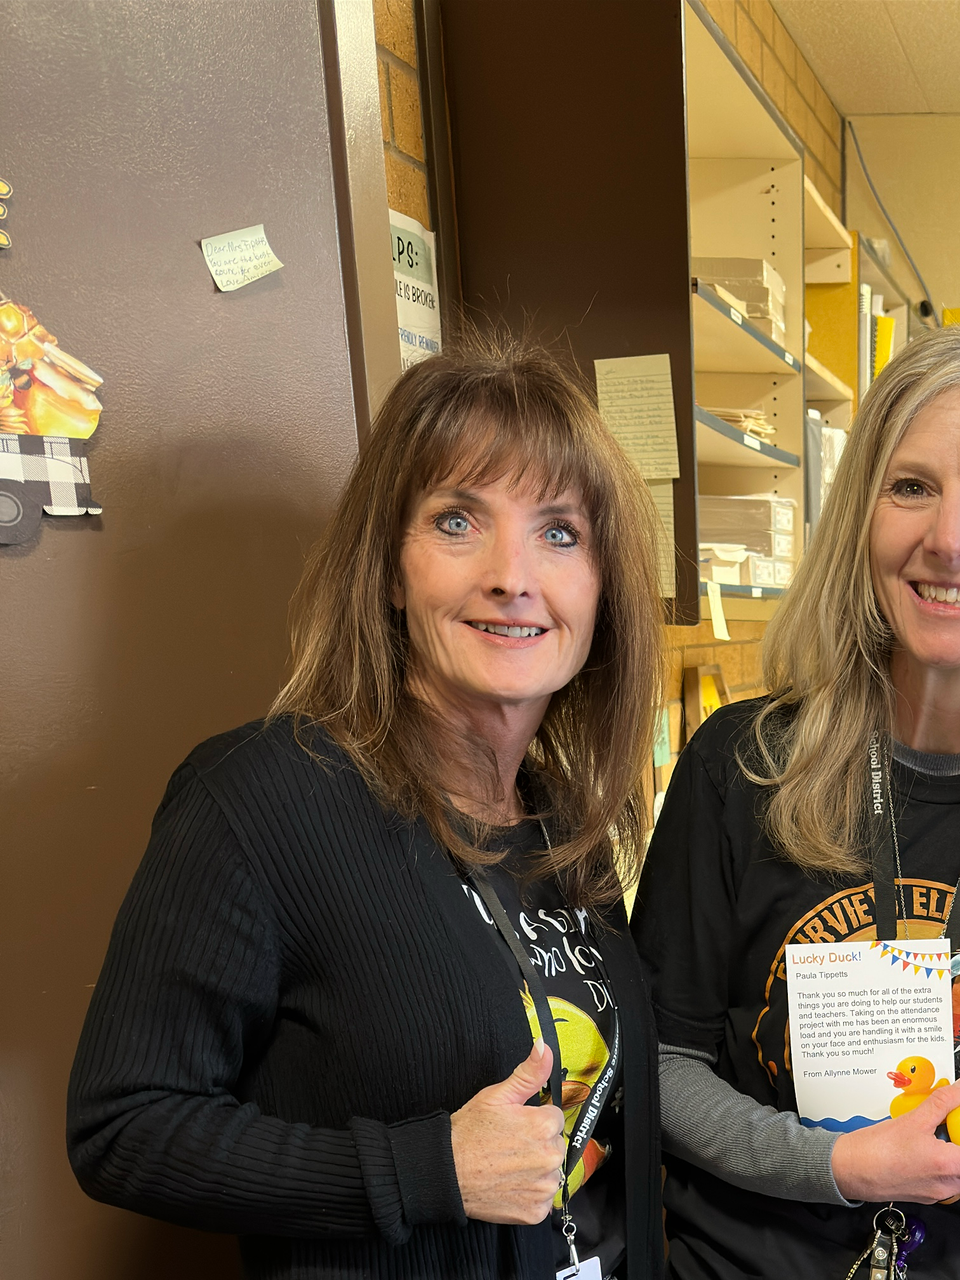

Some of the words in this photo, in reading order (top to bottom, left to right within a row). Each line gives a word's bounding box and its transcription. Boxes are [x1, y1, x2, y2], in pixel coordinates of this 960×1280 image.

[871, 770, 884, 815] District
[792, 953, 825, 965] Lucky
[829, 951, 861, 962] Duck!
[819, 971, 848, 979] Tippetts
[822, 992, 835, 1000] you
[848, 989, 868, 997] much
[901, 987, 912, 995] the
[798, 1002, 820, 1010] things
[851, 999, 871, 1008] doing
[882, 998, 897, 1007] help
[912, 996, 943, 1004] students
[799, 1012, 812, 1020] and
[814, 1010, 848, 1018] teachers.
[850, 1009, 874, 1018] Taking
[900, 1006, 939, 1014] attendance
[799, 1022, 824, 1030] project
[856, 1018, 869, 1026] has
[871, 1017, 890, 1025] been
[902, 1016, 937, 1024] enormous
[862, 1028, 893, 1037] handling
[901, 1026, 915, 1034] with
[924, 1025, 943, 1033] smile
[812, 1042, 828, 1050] your
[830, 1040, 846, 1048] face
[863, 1037, 904, 1045] enthusiasm
[802, 1050, 824, 1058] Thank
[826, 1050, 840, 1058] you
[824, 1069, 851, 1078] Allynne
[590, 1066, 615, 1108] School
[571, 1107, 598, 1149] District
